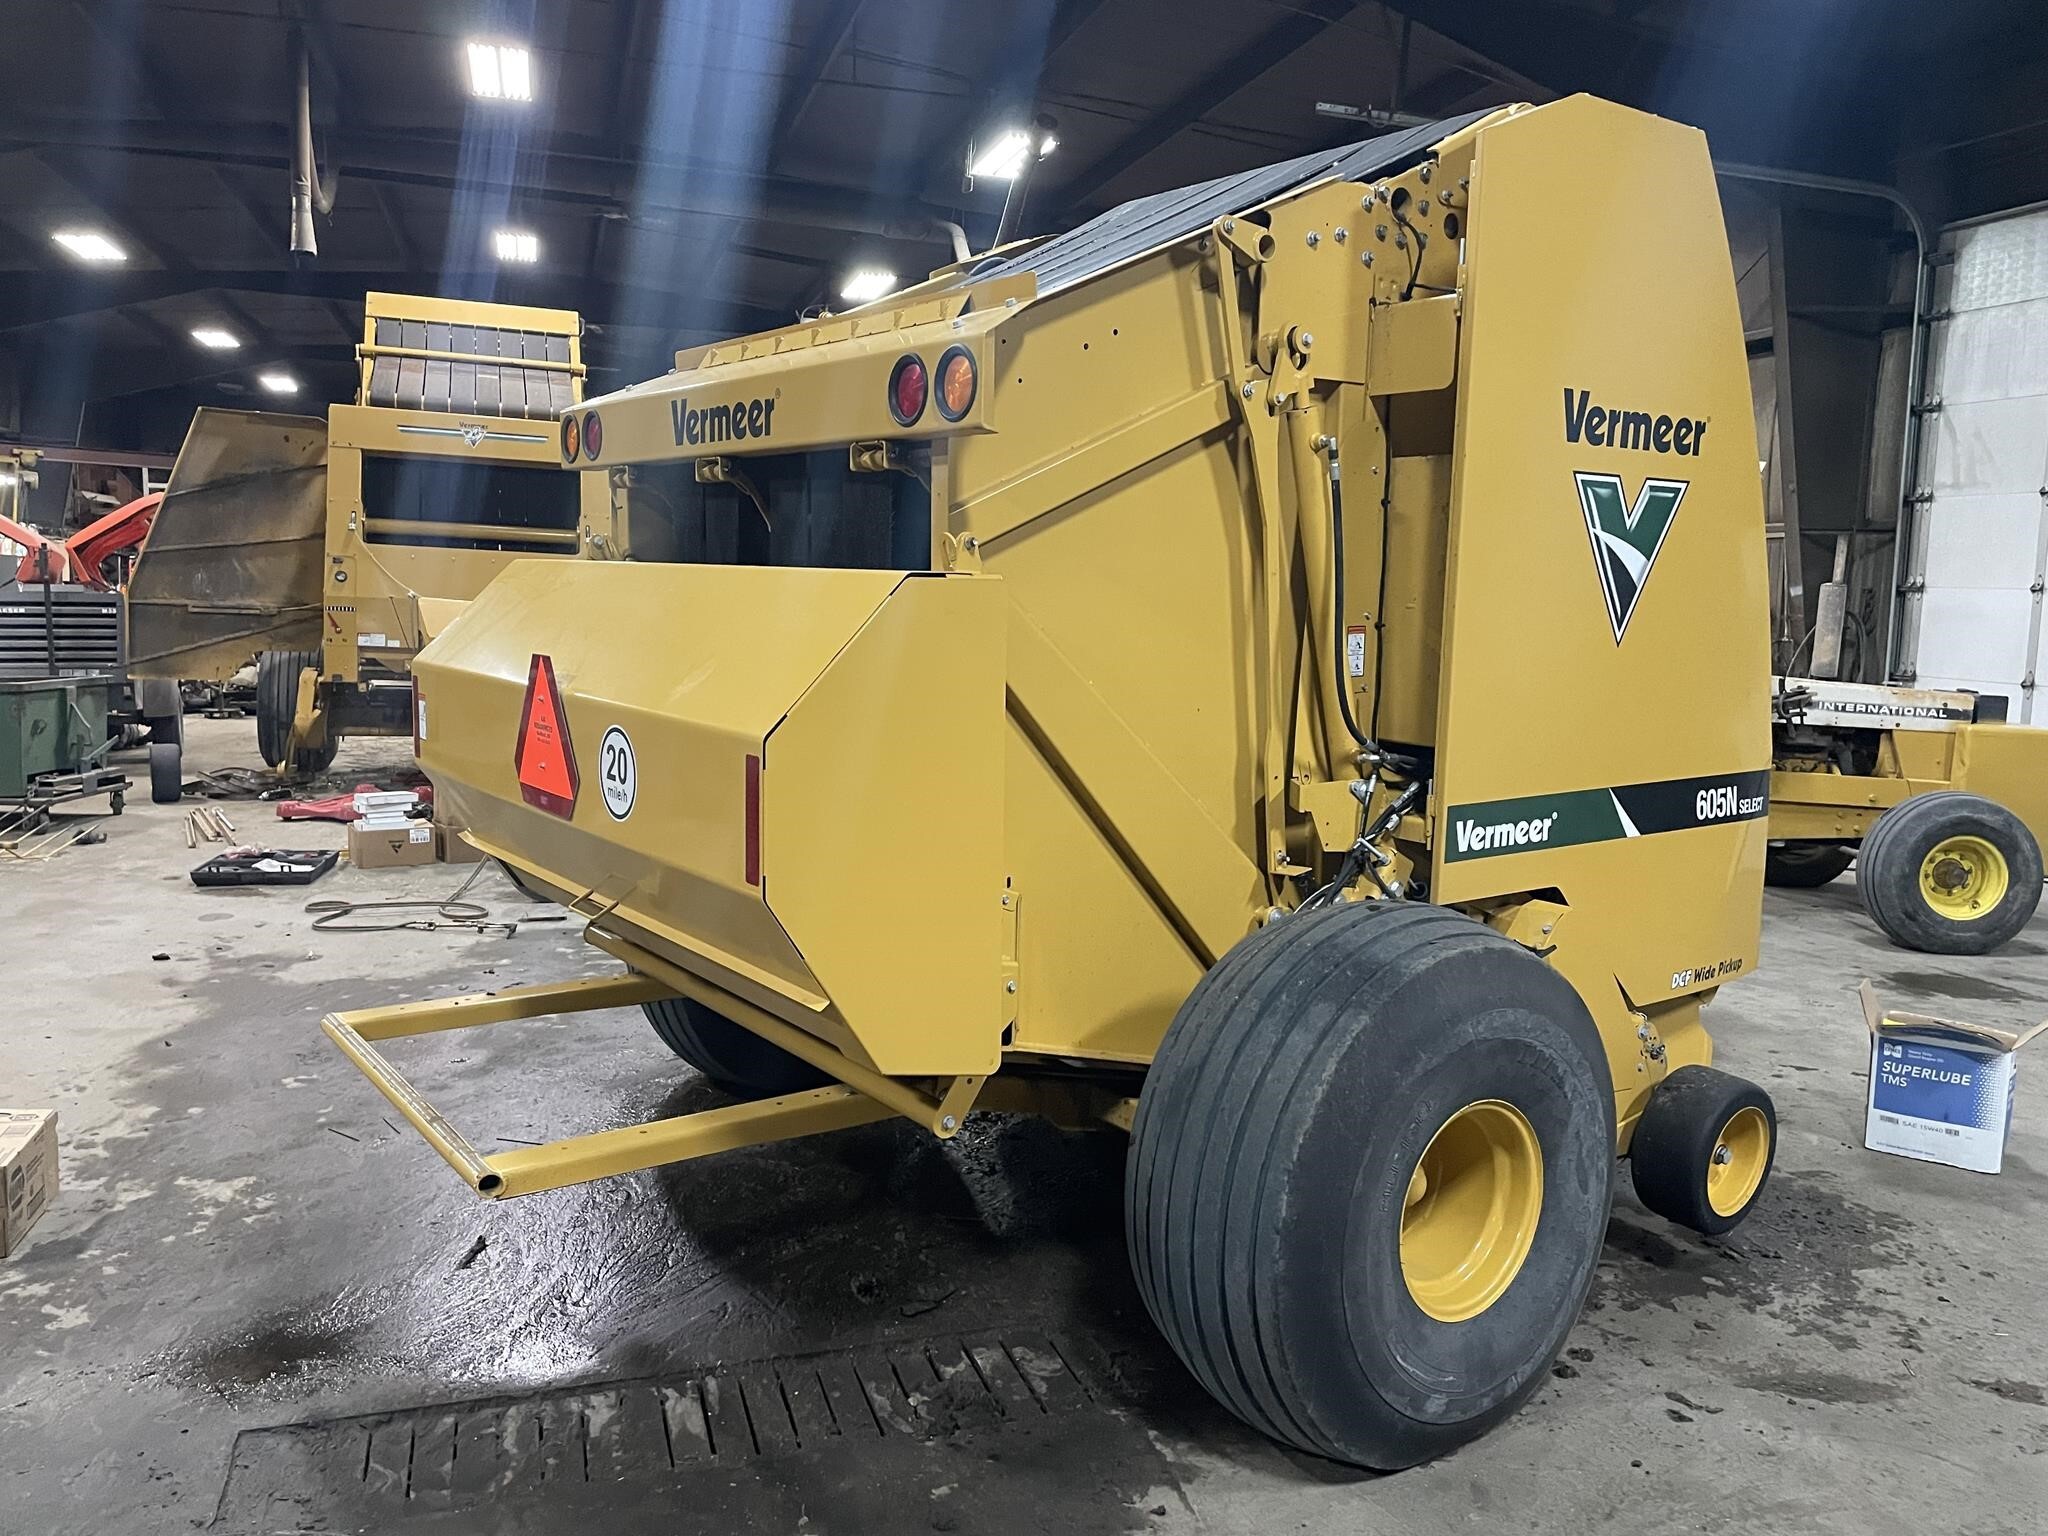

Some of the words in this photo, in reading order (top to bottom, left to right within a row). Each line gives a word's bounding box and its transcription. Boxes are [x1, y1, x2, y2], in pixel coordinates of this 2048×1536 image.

[671, 398, 775, 447] Vermeer
[1563, 387, 1707, 457] Vermeer
[1818, 701, 1948, 718] INTERNATIONAL
[606, 744, 628, 786] 20
[608, 787, 628, 803] mile/h
[1695, 785, 1738, 820] 605N
[1738, 796, 1764, 815] SELECT
[1456, 815, 1553, 853] Vermeer
[1671, 968, 1692, 989] DCF
[1693, 965, 1716, 983] Wide
[1717, 958, 1743, 977] Pickup
[1881, 1073, 1908, 1086] TMS
[1882, 1061, 1972, 1086] SUPERLUBE
[1902, 1121, 1917, 1129] SAE
[1920, 1125, 1944, 1134] 15W40
